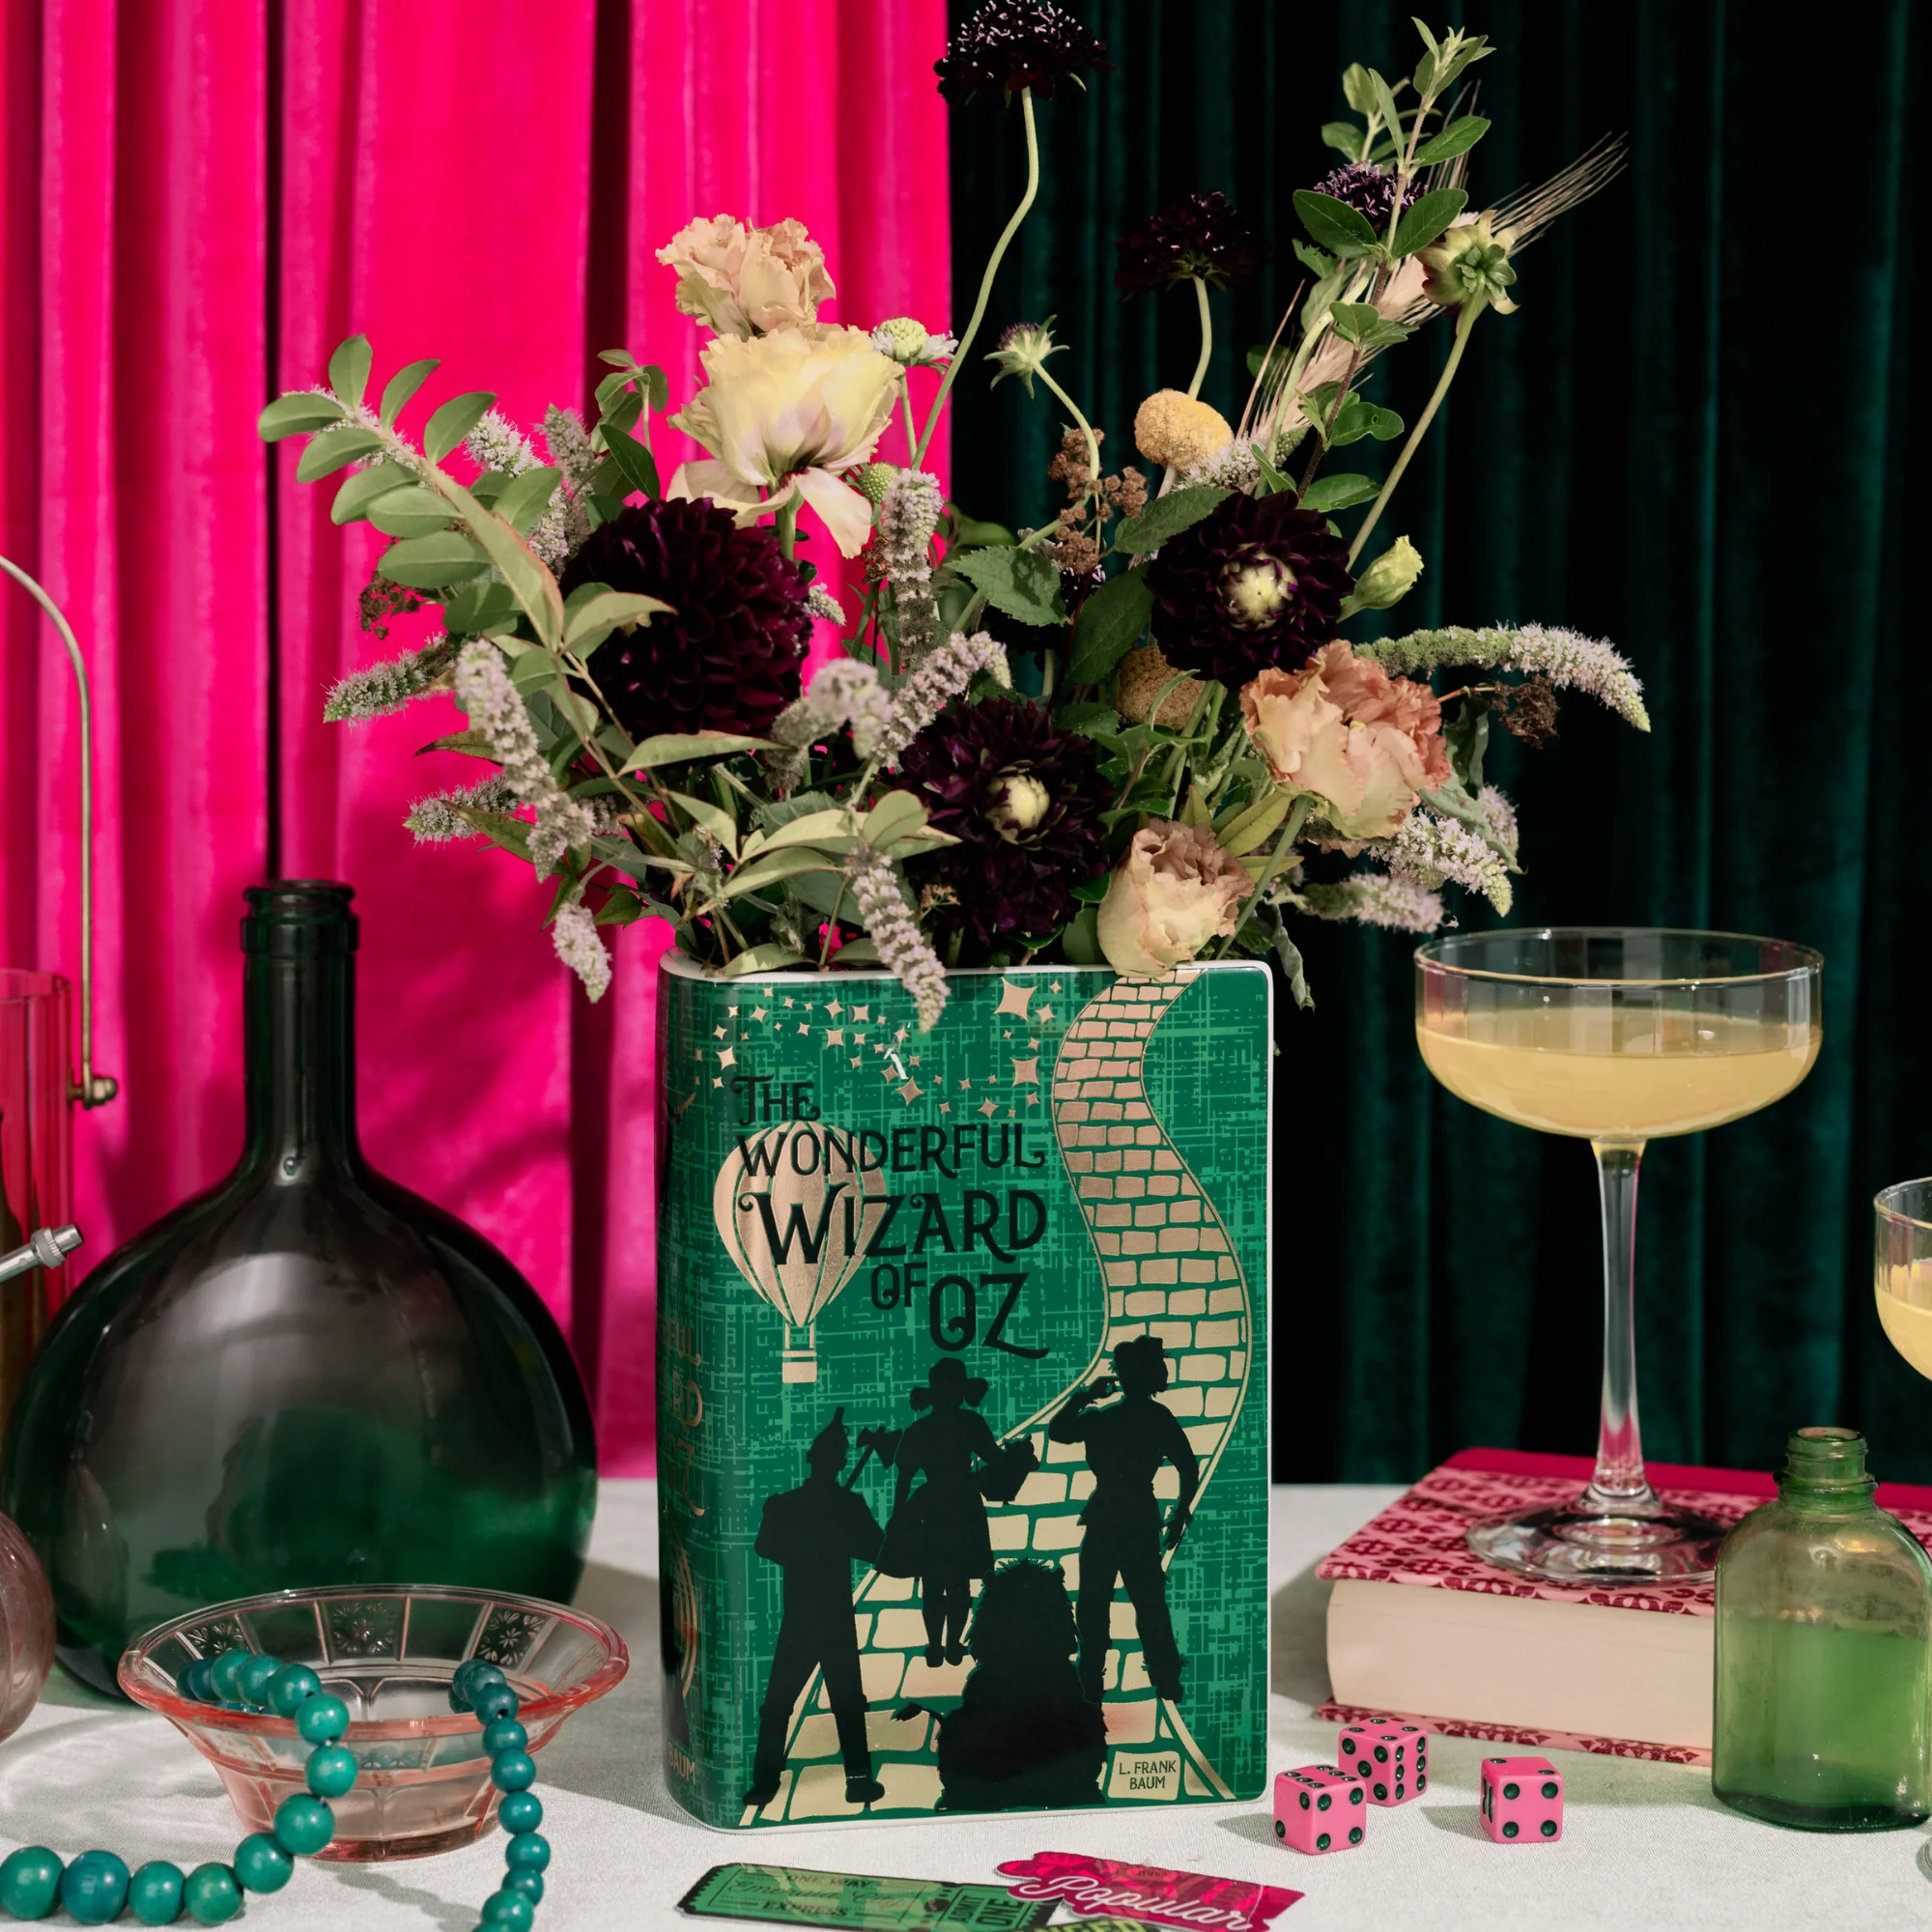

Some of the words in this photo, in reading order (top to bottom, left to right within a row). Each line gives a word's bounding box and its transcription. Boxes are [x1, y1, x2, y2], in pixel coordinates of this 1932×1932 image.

[730, 1074, 821, 1125] THE
[737, 1122, 1046, 1179] WONDERFUL
[738, 1182, 1047, 1265] WIZARD
[870, 1262, 927, 1310] OF
[929, 1271, 1050, 1359] OZ
[1119, 1762, 1131, 1776] L.
[1134, 1760, 1177, 1775] FRANK
[1129, 1776, 1166, 1790] BAUM
[830, 1878, 872, 1888] WAY
[1019, 1875, 1253, 1930] Popular
[763, 1900, 850, 1918] EXPRESS
[975, 1897, 1024, 1927] ONE
